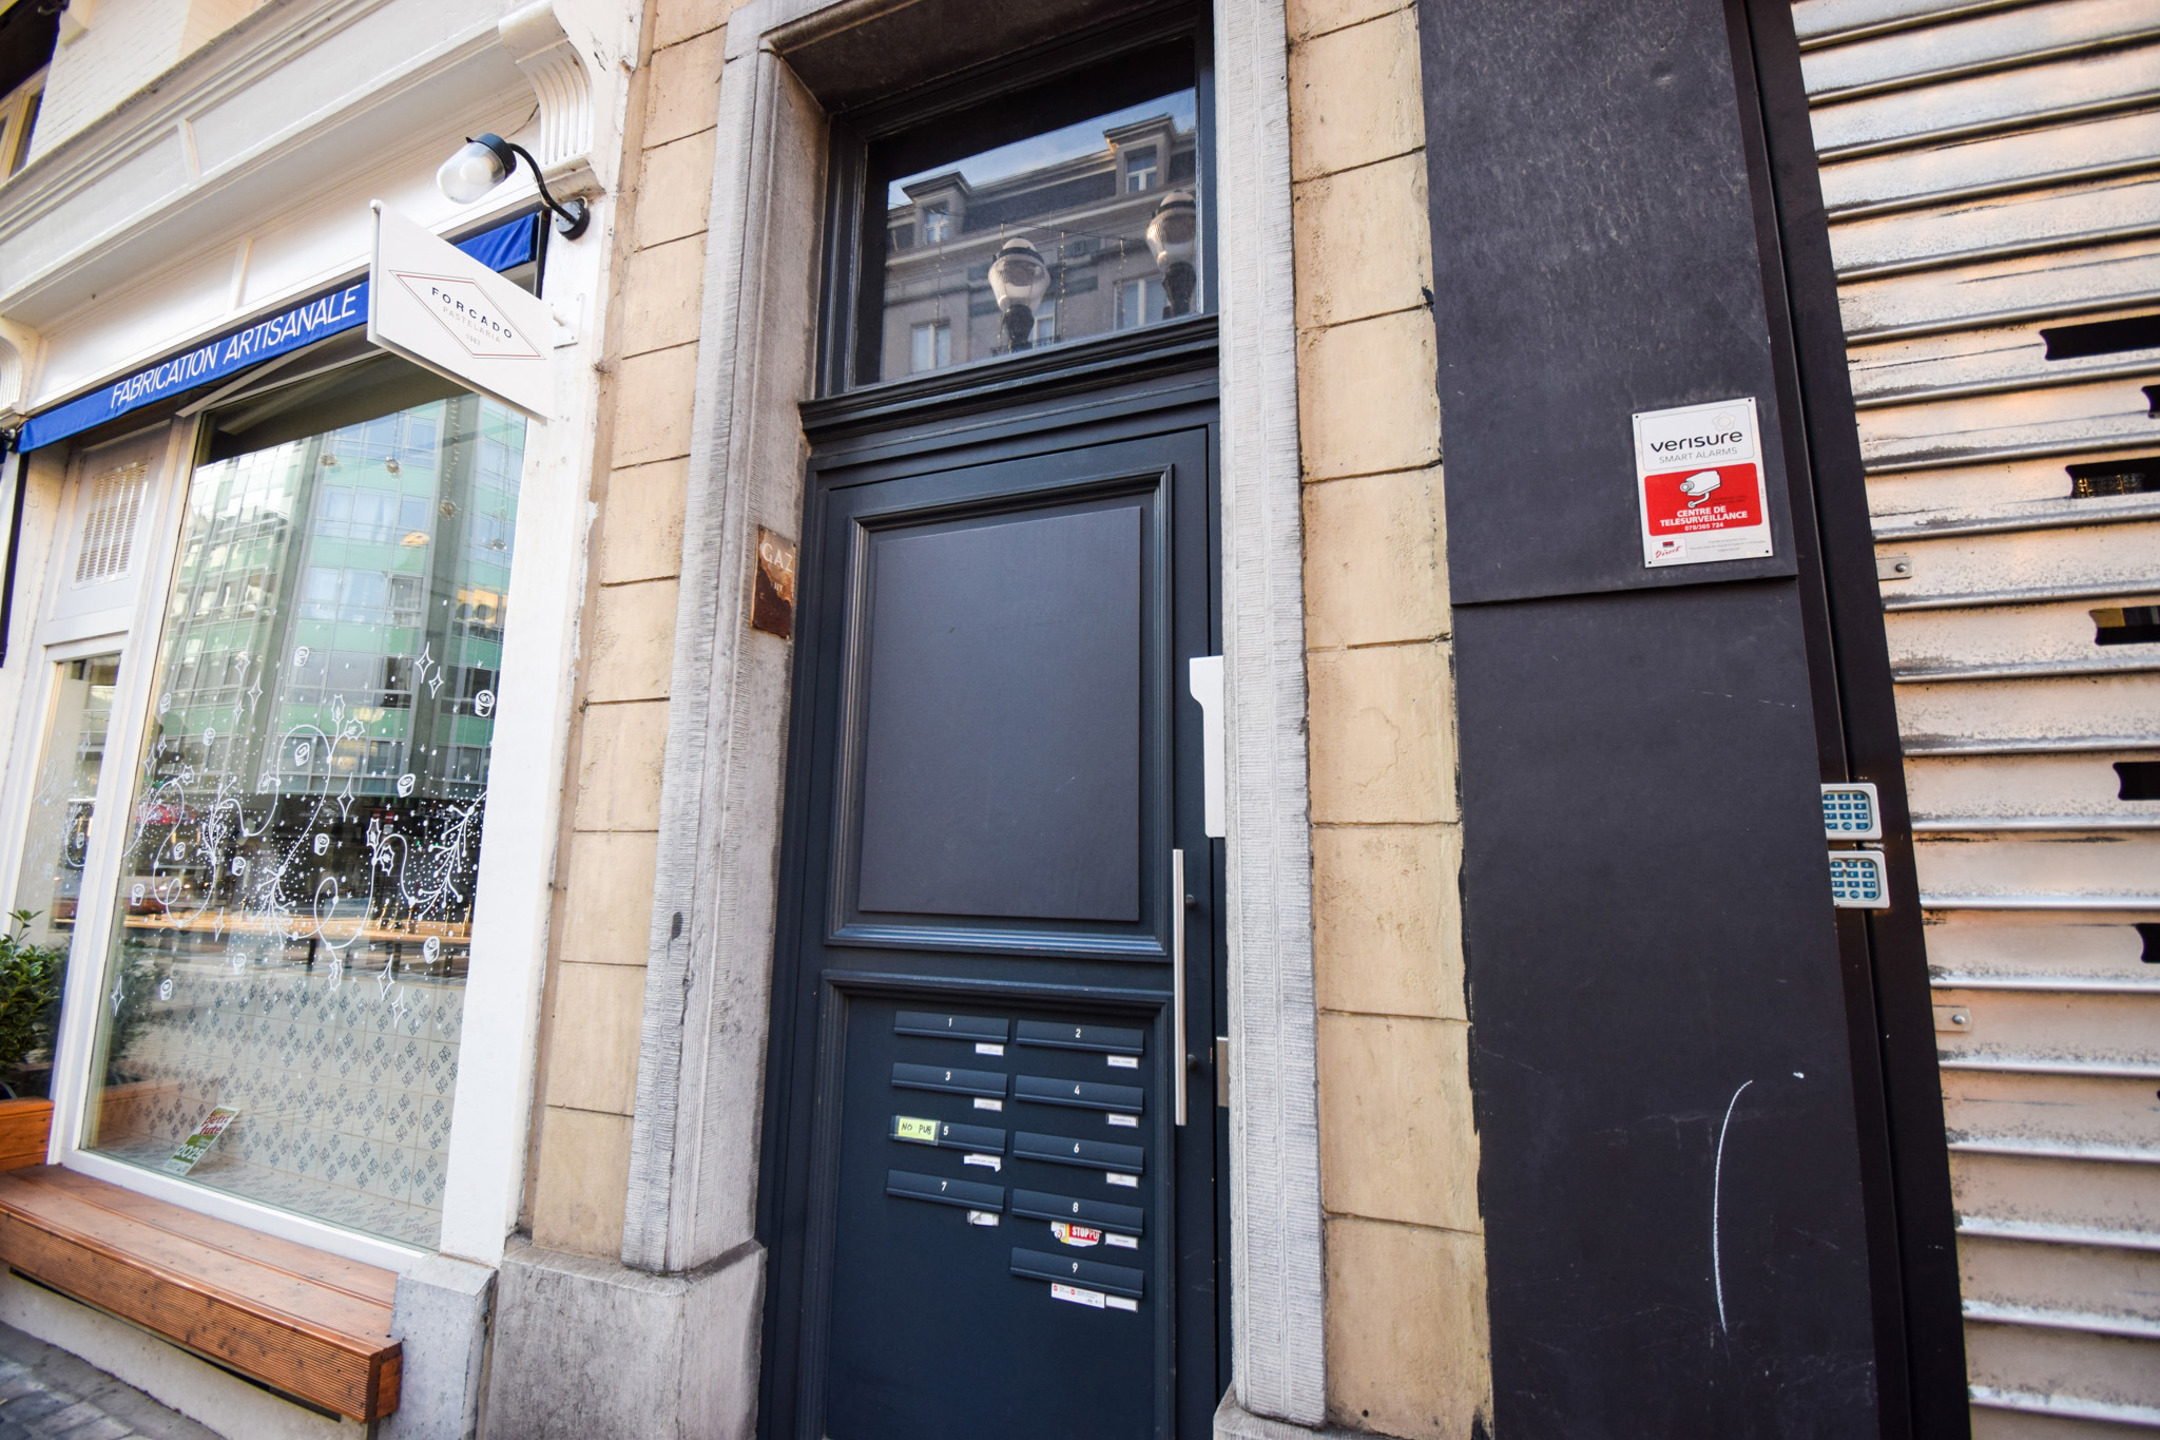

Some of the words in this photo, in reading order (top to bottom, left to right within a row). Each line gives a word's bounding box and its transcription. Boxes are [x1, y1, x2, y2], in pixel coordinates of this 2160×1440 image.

[432, 287, 512, 338] FORCADO
[443, 306, 501, 343] PASTELARIA
[110, 341, 221, 409] FABRICATION
[222, 283, 361, 365] ARTISANALE
[1650, 431, 1743, 453] verisure
[1659, 452, 1694, 464] SMART
[1695, 446, 1738, 460] ALARMS
[1676, 507, 1712, 518] CENTRE
[1713, 505, 1727, 514] DE
[1660, 511, 1748, 527] TELESURVEILLANCE
[761, 542, 793, 573] GAZ
[948, 1018, 953, 1028] 1
[1075, 1028, 1082, 1038] 2
[945, 1072, 951, 1082] 3
[1074, 1086, 1081, 1095] 4
[902, 1122, 913, 1131] NO
[944, 1126, 949, 1136] 5
[1073, 1144, 1080, 1154] 6
[941, 1182, 948, 1192] 7
[1072, 1202, 1079, 1213] 8
[1072, 1226, 1089, 1238] STOP
[1072, 1262, 1079, 1273] 9
